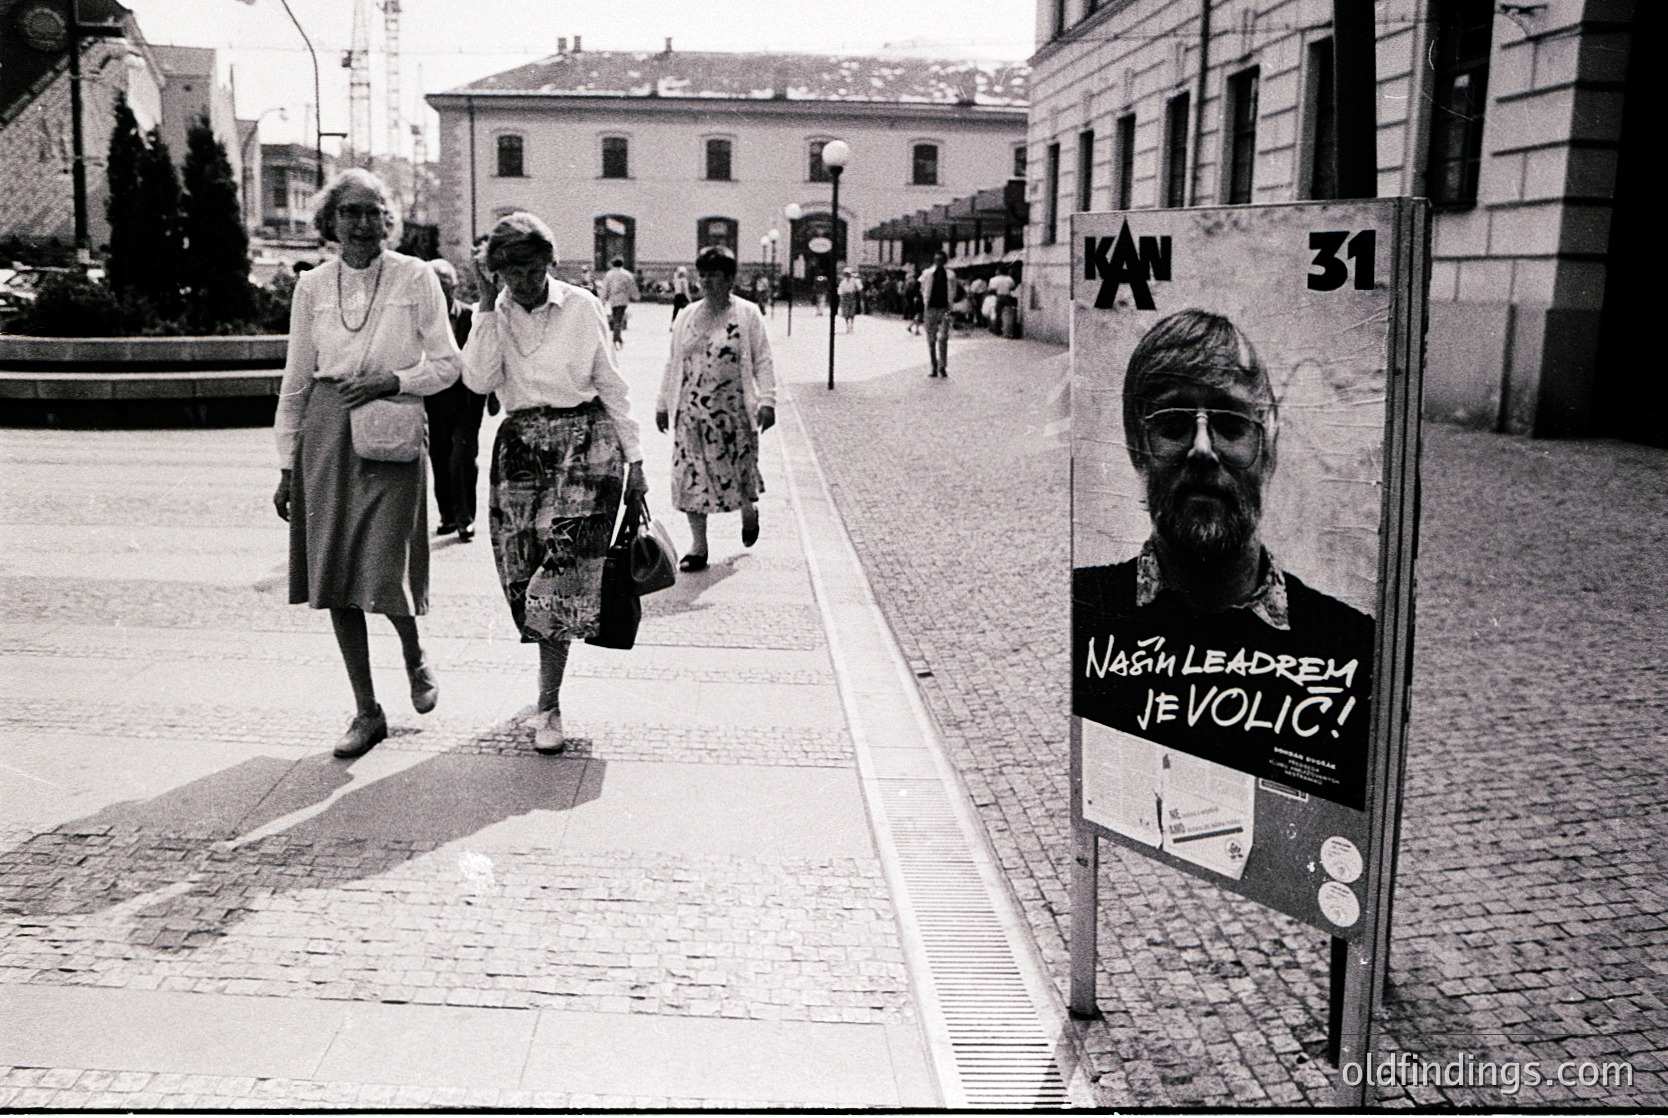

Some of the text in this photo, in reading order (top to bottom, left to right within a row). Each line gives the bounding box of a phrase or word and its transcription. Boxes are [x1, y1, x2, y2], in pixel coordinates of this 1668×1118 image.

[1085, 215, 1173, 310] KAN
[1307, 229, 1376, 291] 31
[1182, 644, 1358, 688] LEADREM
[1137, 689, 1179, 730] JE
